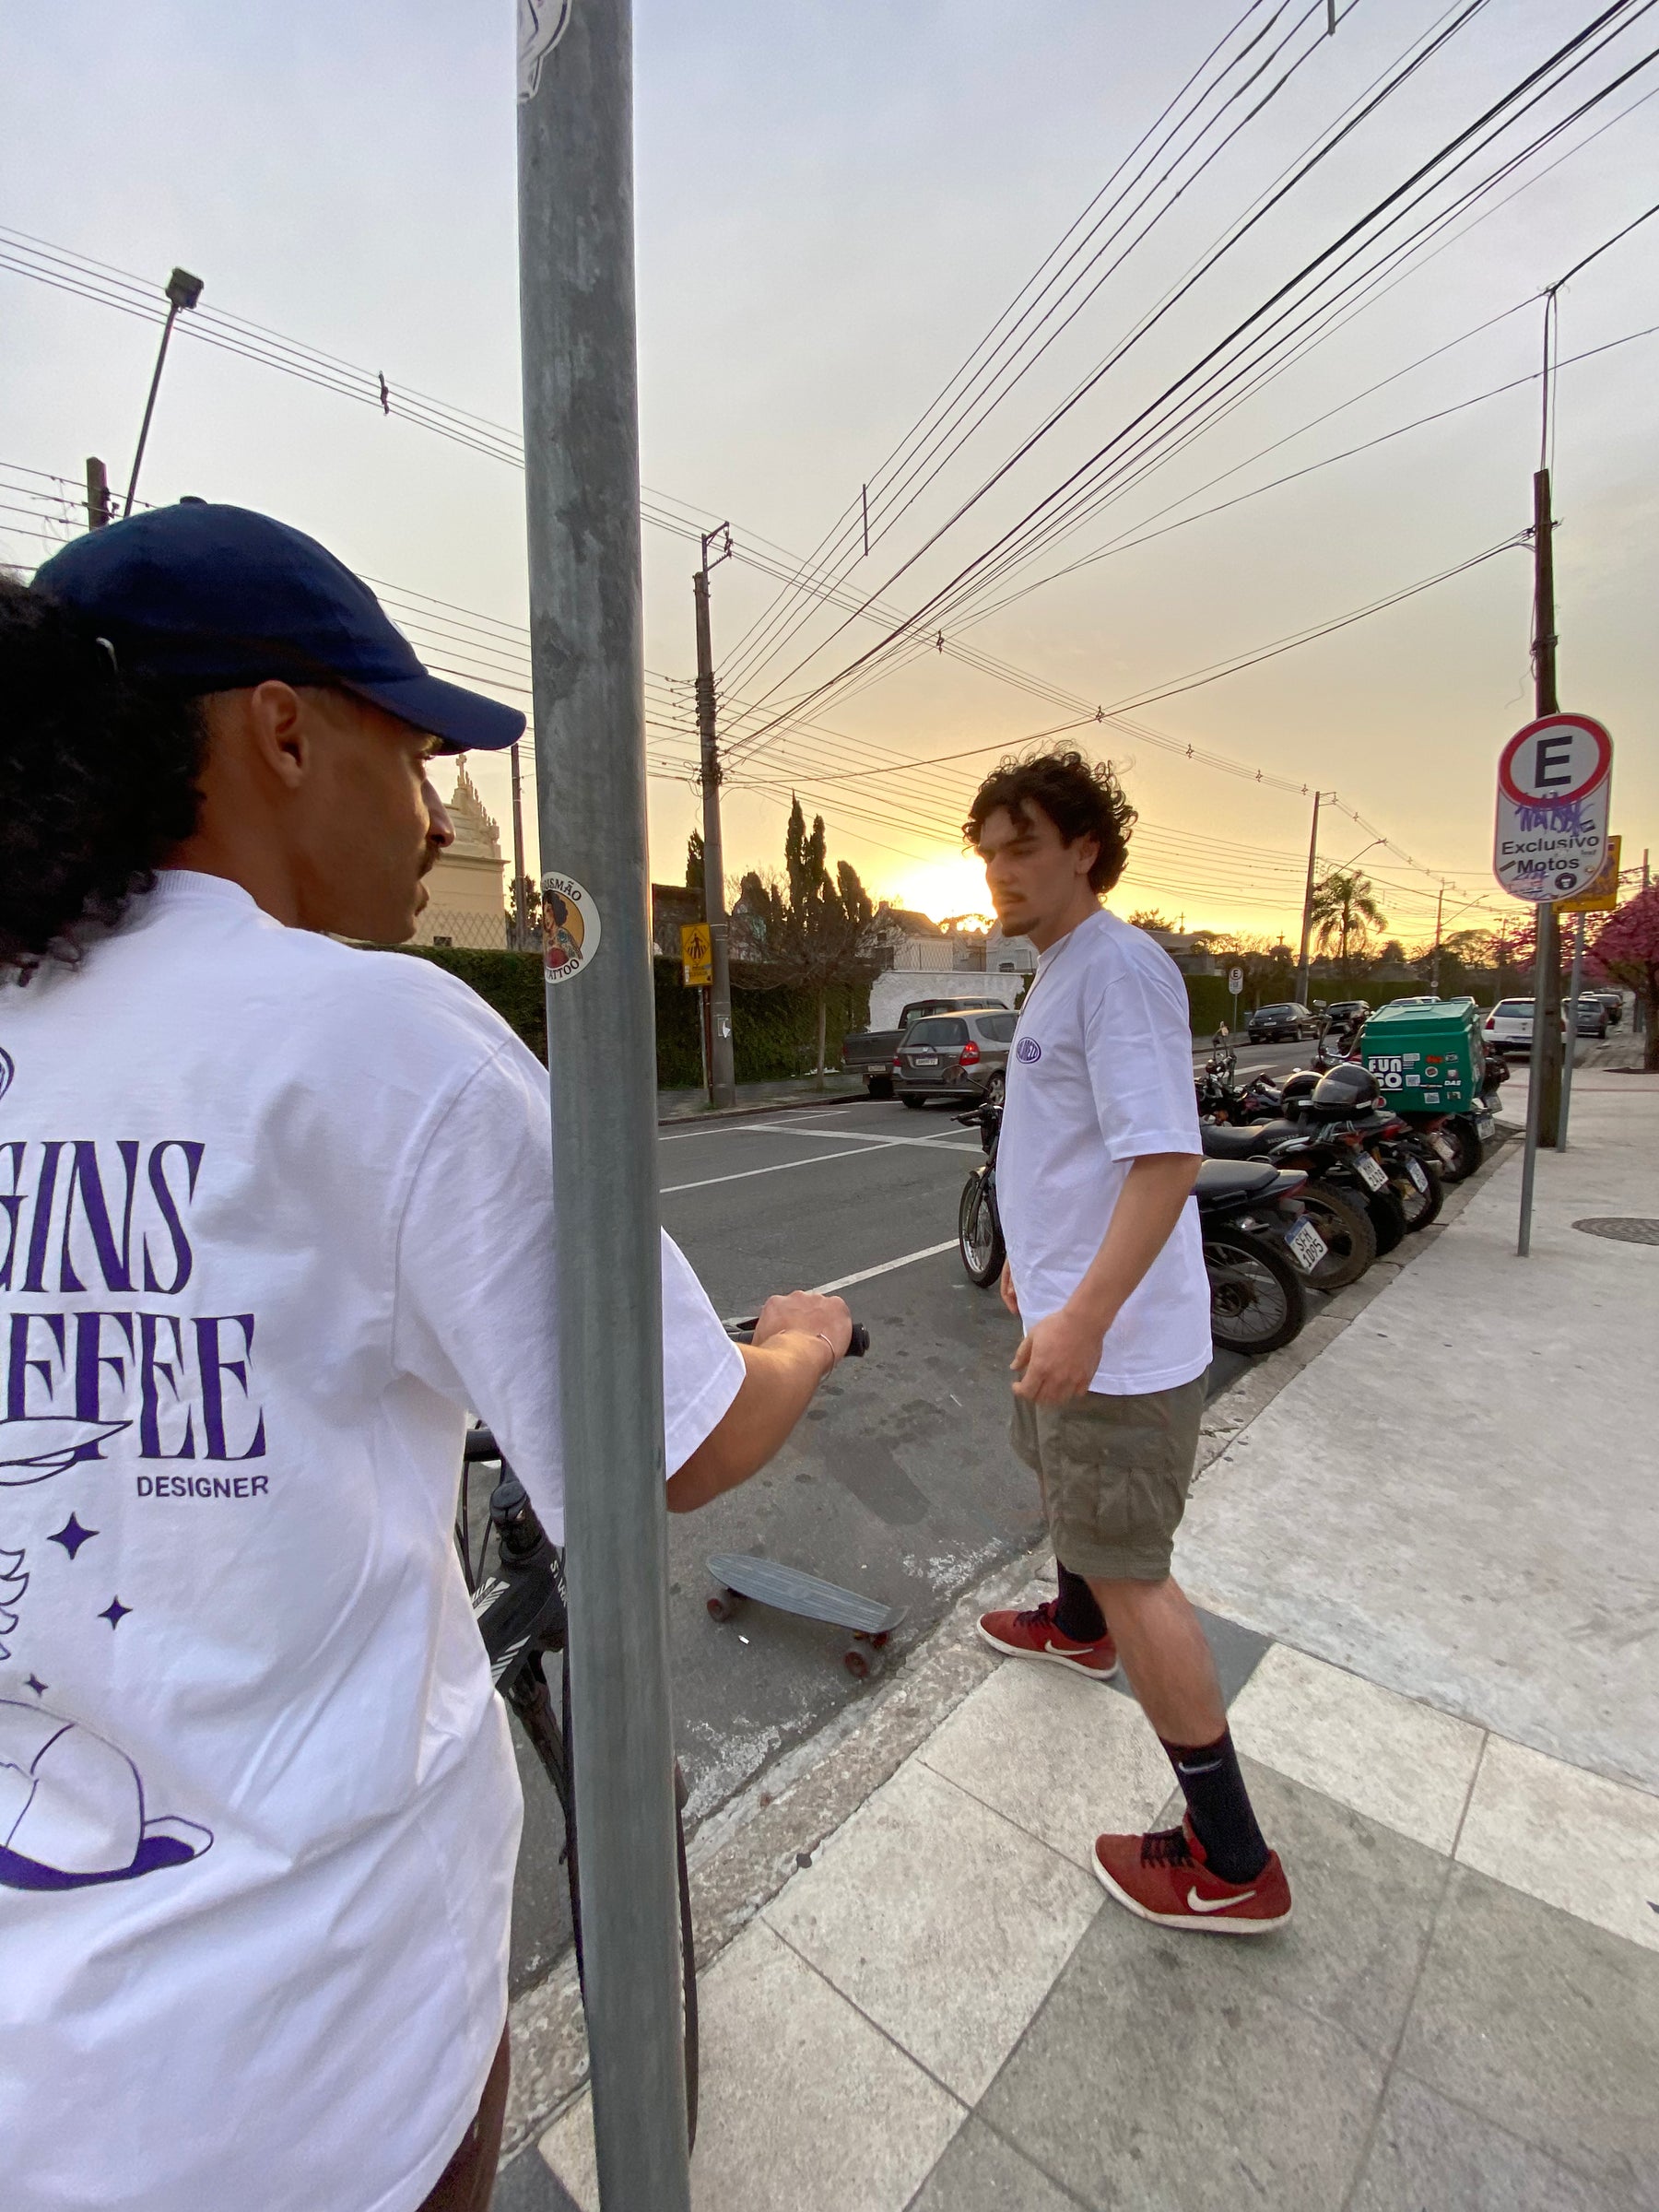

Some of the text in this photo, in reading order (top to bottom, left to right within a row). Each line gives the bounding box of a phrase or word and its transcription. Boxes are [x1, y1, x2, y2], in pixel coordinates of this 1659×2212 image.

[1535, 735, 1573, 788] E
[1501, 835, 1600, 855] Exclusivo
[1517, 857, 1580, 874] Motos
[544, 877, 582, 901] USMÃO
[1232, 969, 1239, 978] E
[1368, 1058, 1403, 1073] FUN
[1295, 1228, 1313, 1252] SFH
[137, 1476, 269, 1498] DESIGNER
